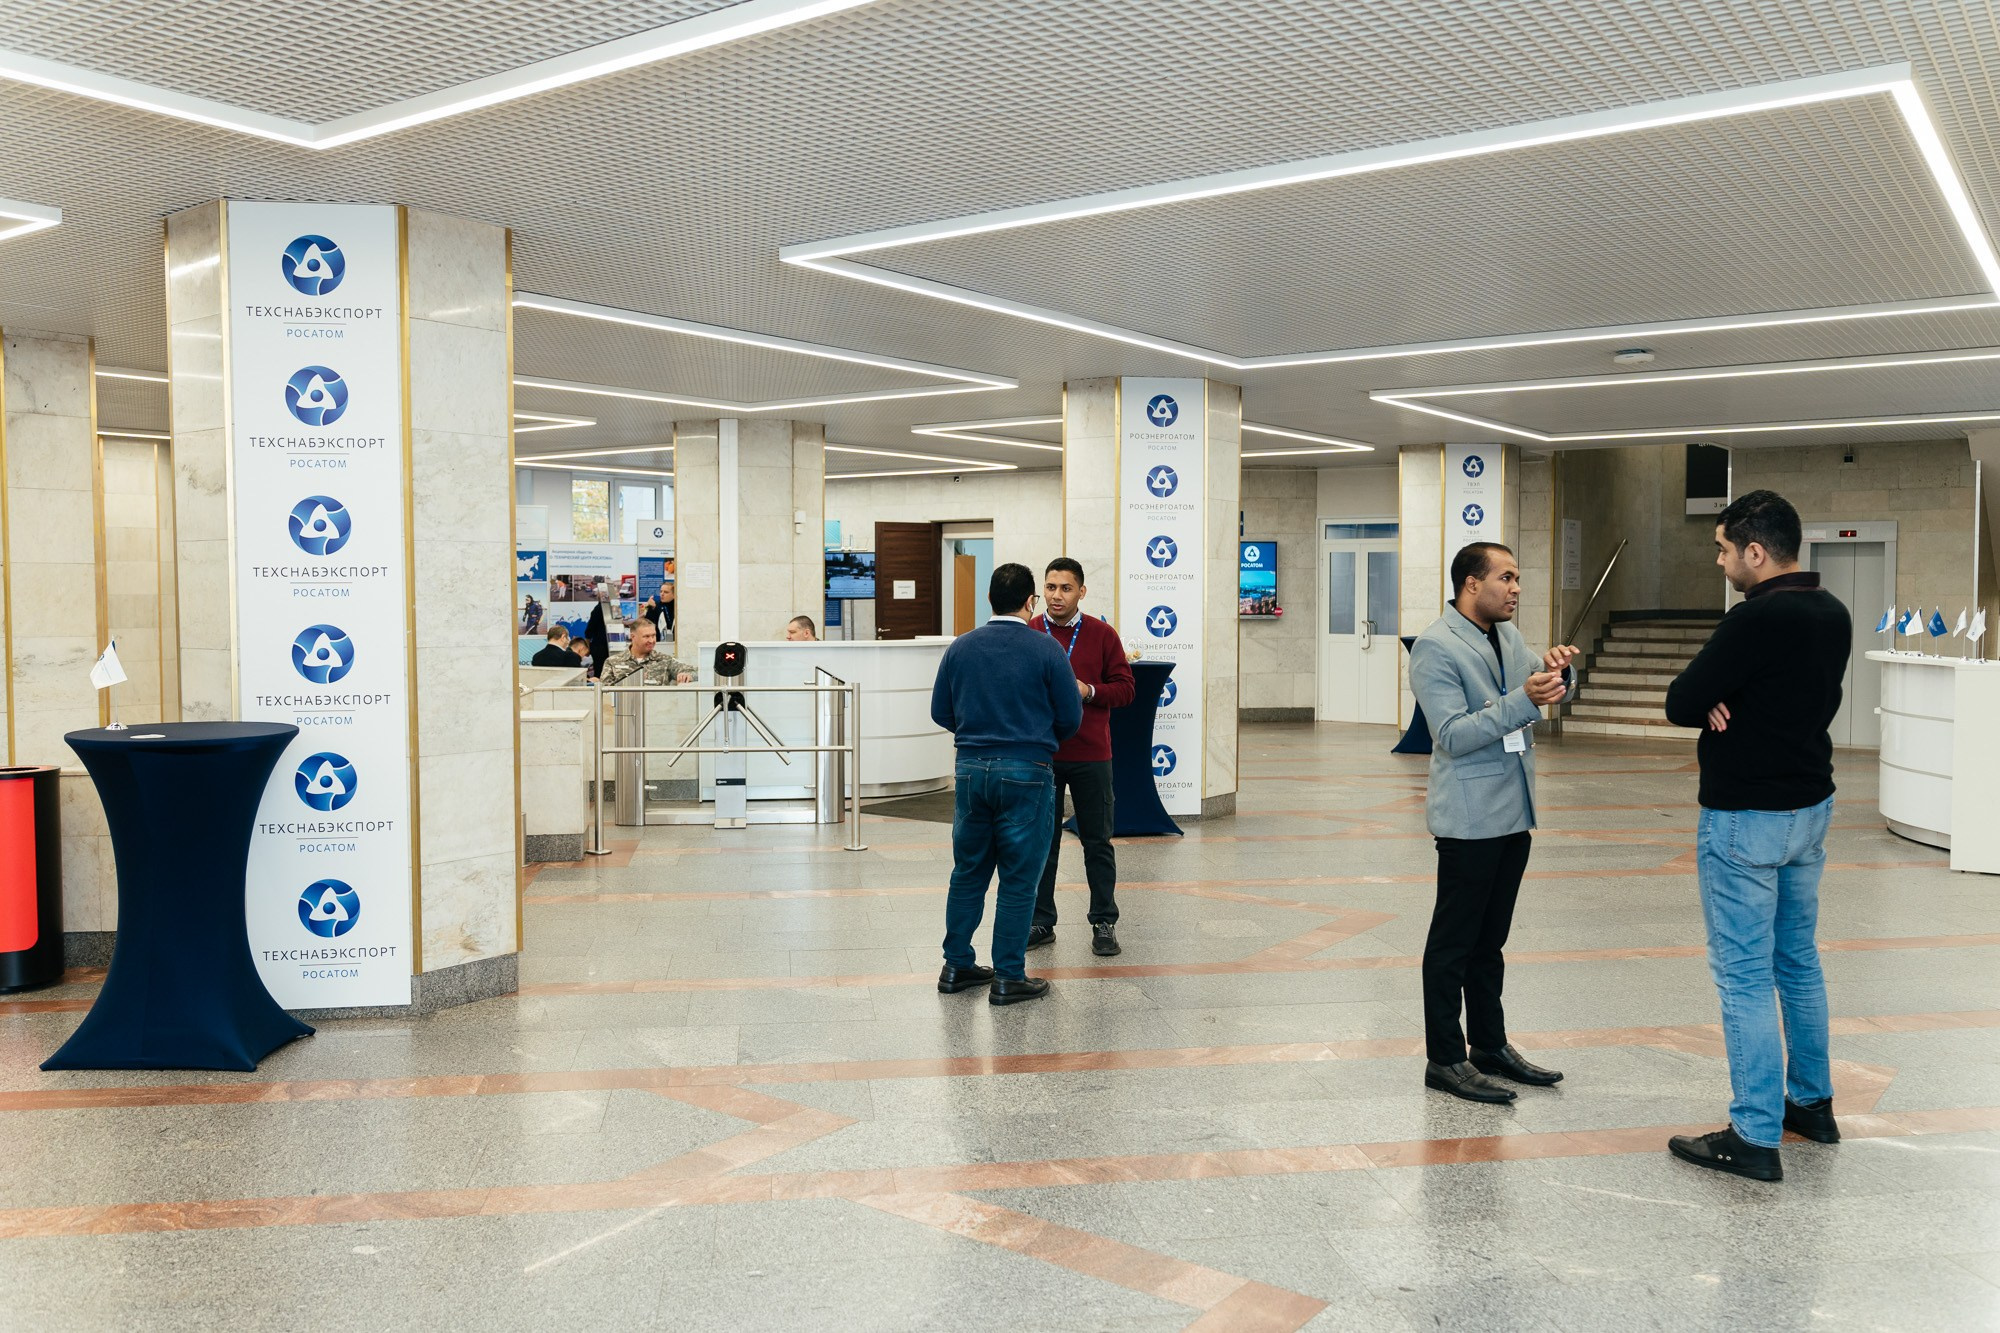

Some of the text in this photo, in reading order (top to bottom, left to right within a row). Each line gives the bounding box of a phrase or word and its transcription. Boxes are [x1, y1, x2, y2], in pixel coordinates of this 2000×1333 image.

[245, 305, 383, 319] ТЕХСНАБЭКСПОРТ
[286, 329, 344, 339] РОСАТОМ
[1129, 432, 1195, 441] РОСЭНЕРГОАТОМ
[249, 437, 386, 449] ТЕХСНАБЭКСПОРТ
[290, 460, 347, 468] РОСАТОМ
[1129, 503, 1195, 511] РОСЭНЕРГОАТОМ
[253, 566, 388, 578] ТЕХСНАБЭКСПОРТ
[1129, 573, 1194, 581] РОСЭНЕРГОАТОМ
[293, 588, 350, 597] РОСАТОМ
[256, 694, 391, 707] ТЕХСНАБЭКСПОРТ
[296, 716, 353, 726] РОСАТОМ
[260, 821, 394, 834] ТЕХСНАБЭКСПОРТ
[299, 844, 356, 853] РОСАТОМ
[262, 946, 397, 961] ТЕХСНАБЭКСПОРТ
[302, 970, 359, 979] РОСАТОМ
